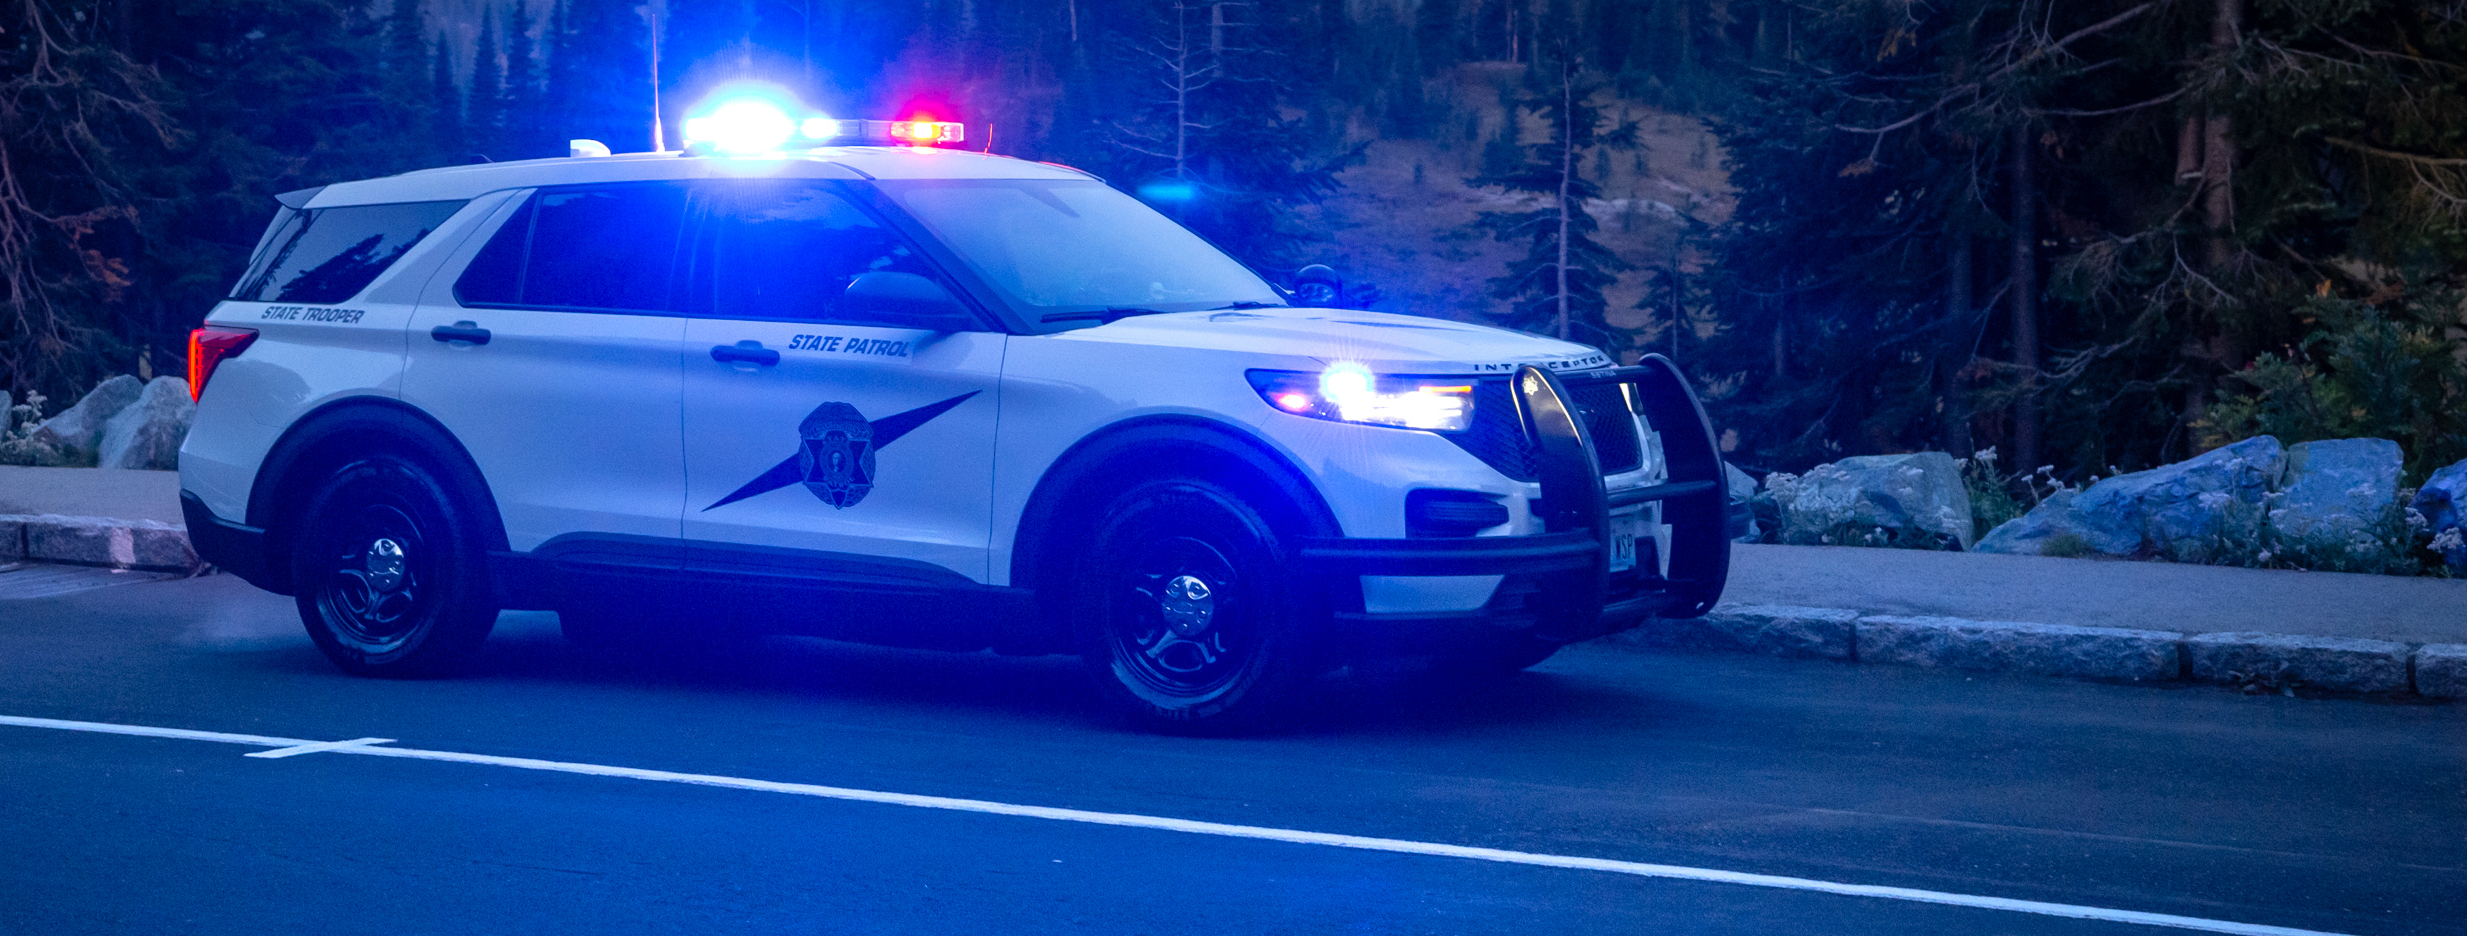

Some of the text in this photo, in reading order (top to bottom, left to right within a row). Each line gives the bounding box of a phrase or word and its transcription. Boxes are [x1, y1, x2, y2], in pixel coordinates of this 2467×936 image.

[261, 306, 365, 324] STATE TROOPER
[788, 334, 910, 357] STATE PATROL
[1474, 355, 1605, 371] INTCEPTOR
